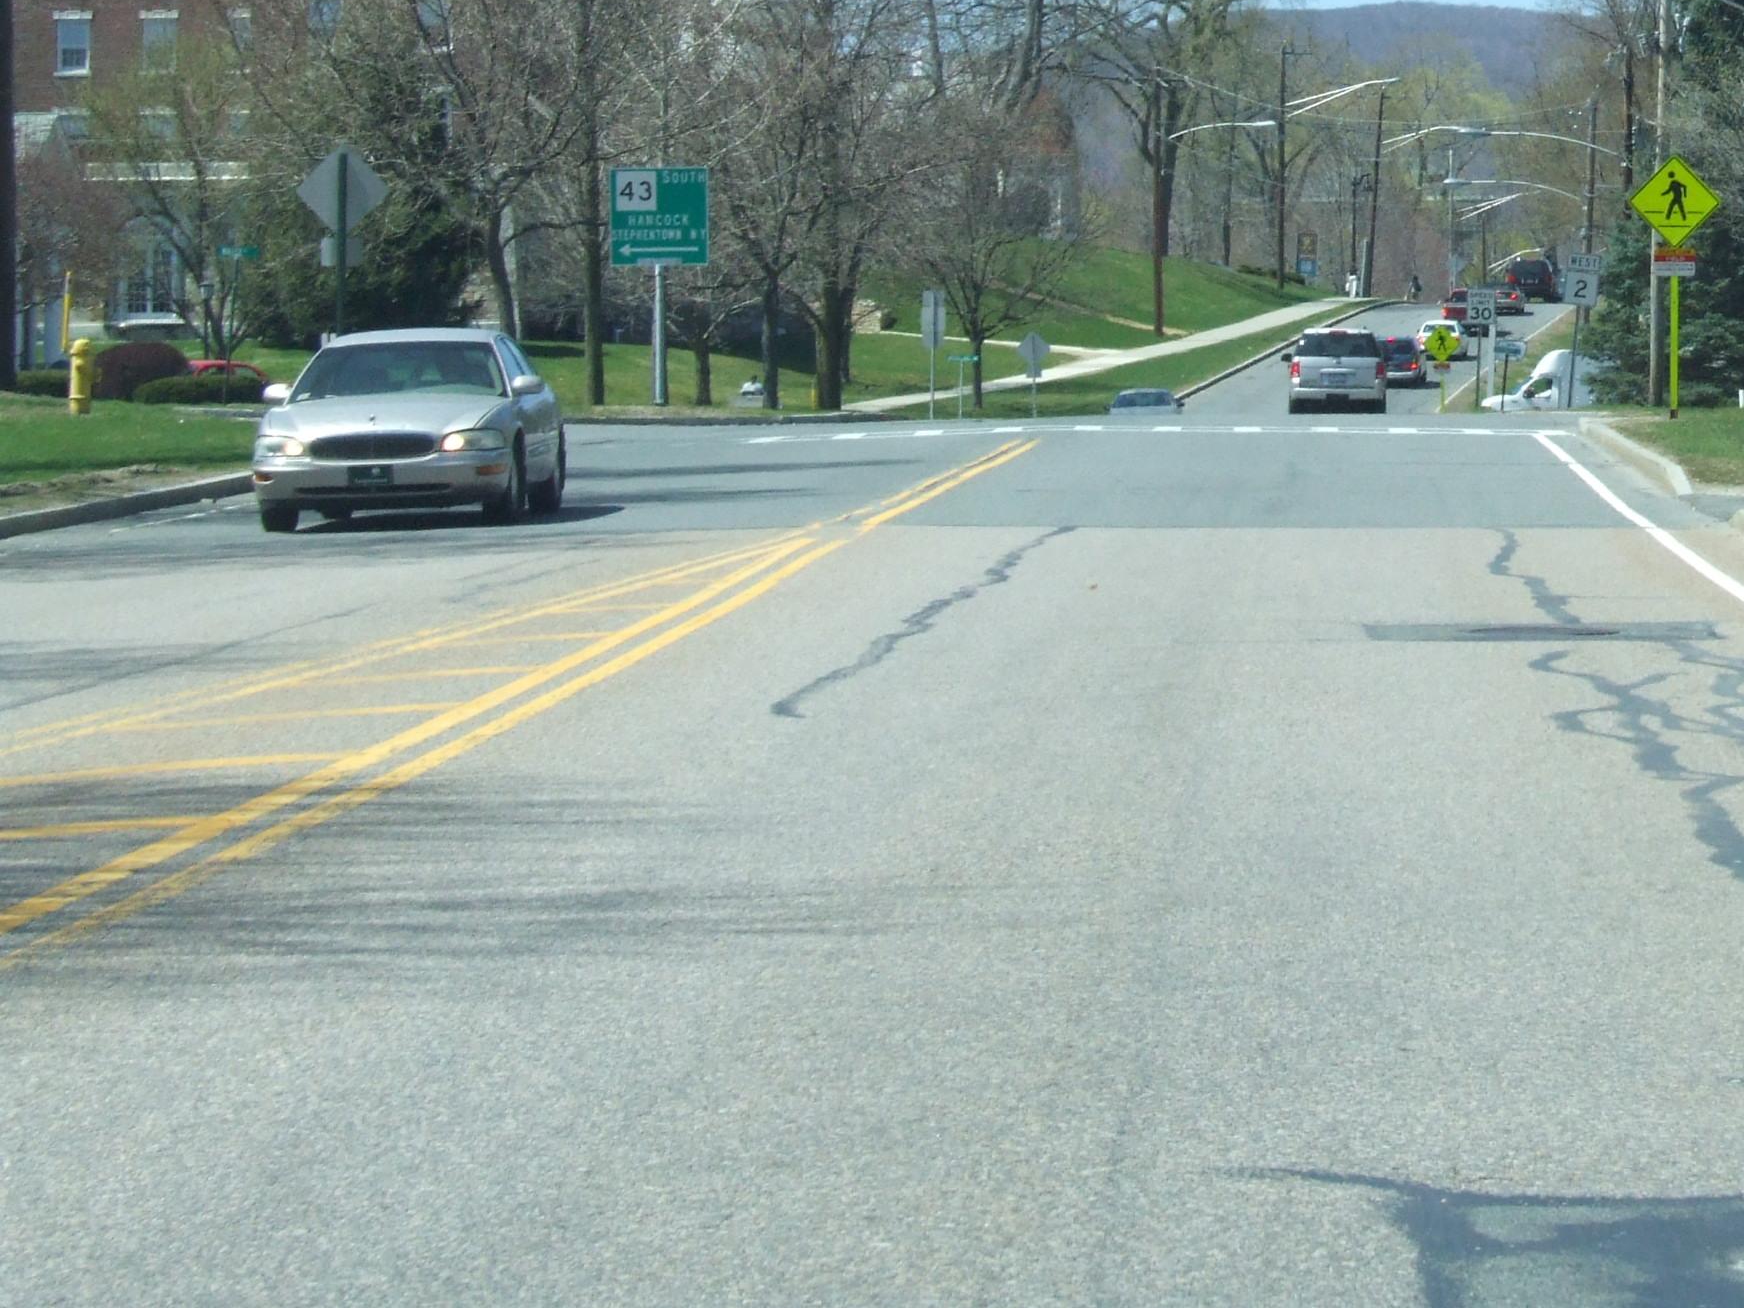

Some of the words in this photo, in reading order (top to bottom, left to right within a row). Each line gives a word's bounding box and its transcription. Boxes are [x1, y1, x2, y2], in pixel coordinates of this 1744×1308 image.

[662, 171, 705, 183] SOUTH
[620, 181, 652, 201] 43
[628, 215, 689, 226] HANCOCK
[612, 229, 682, 241] STEPHENTOWN
[1570, 255, 1597, 268] WEST
[1574, 280, 1588, 298] 2
[1470, 307, 1492, 320] 30
